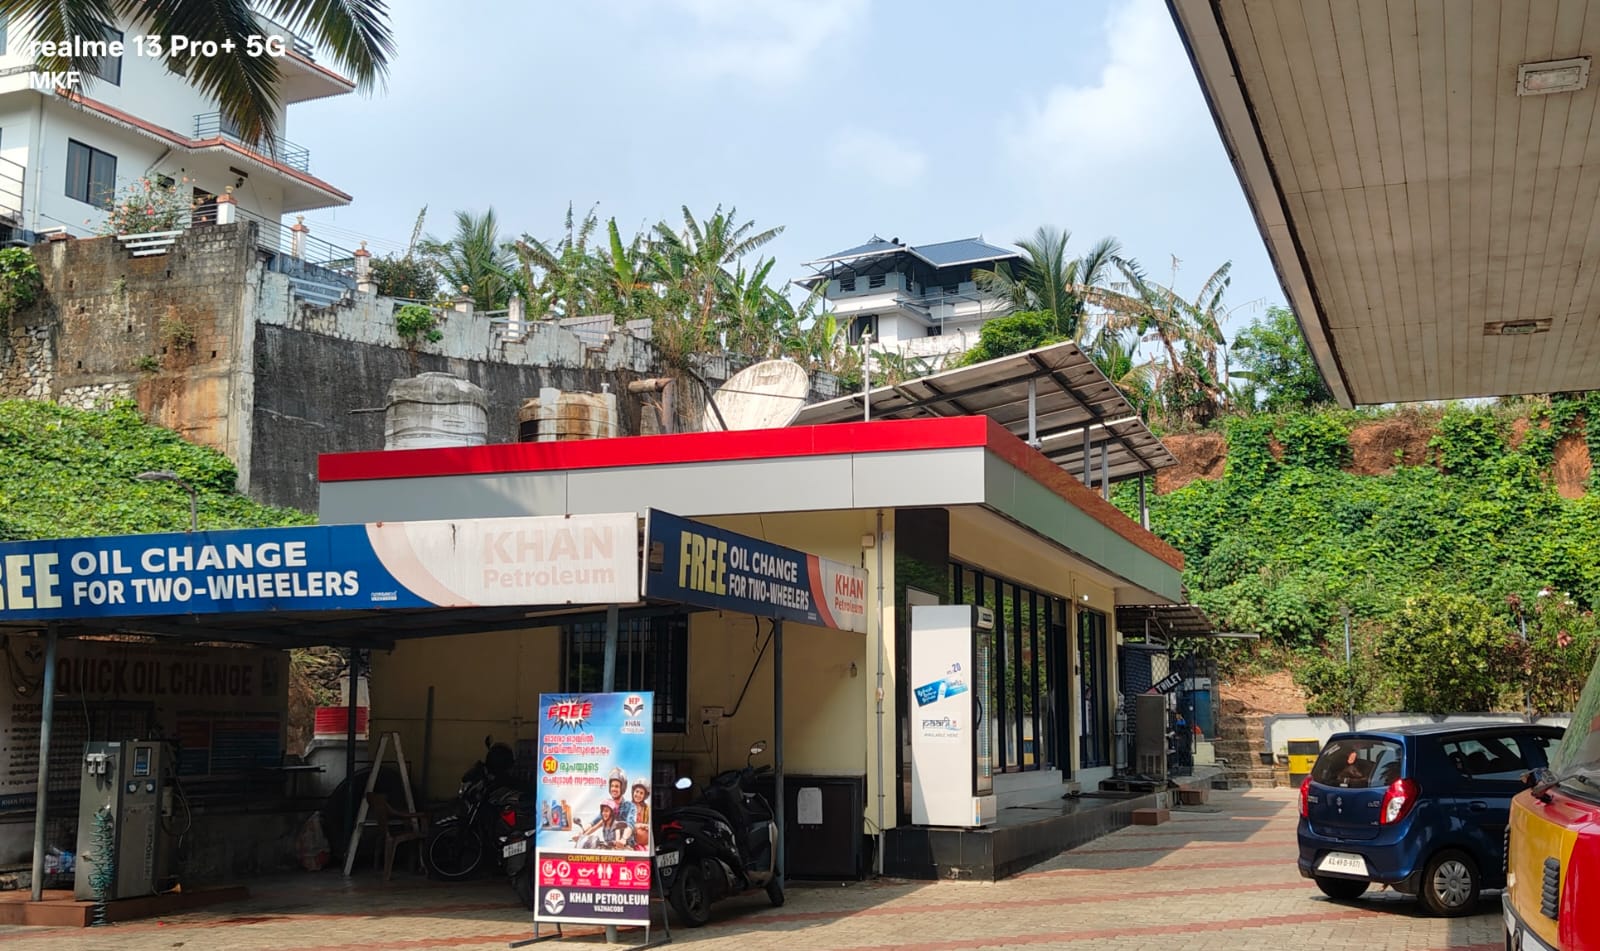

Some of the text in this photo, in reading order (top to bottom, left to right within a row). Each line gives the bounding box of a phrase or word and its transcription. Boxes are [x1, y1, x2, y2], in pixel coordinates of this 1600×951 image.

[482, 526, 615, 564] KHAN
[71, 549, 132, 577] OIL
[141, 541, 307, 572] CHANGE
[678, 530, 798, 596] FREE OIL CHANGE
[73, 570, 360, 606] FOR TWO-WHEELERS
[483, 564, 615, 590] Petroleum
[834, 574, 864, 600] KHAN
[728, 581, 810, 611] FOR TWO-WHEELERS
[834, 596, 864, 615] Petroleum
[57, 656, 127, 695] QUICK
[132, 660, 166, 694] OIL
[1155, 672, 1182, 694] TOILET
[547, 703, 593, 720] FREE
[628, 697, 641, 705] HP
[545, 759, 557, 772] 50
[550, 893, 561, 901] HP
[569, 893, 649, 906] KHAN PETROLEUM
